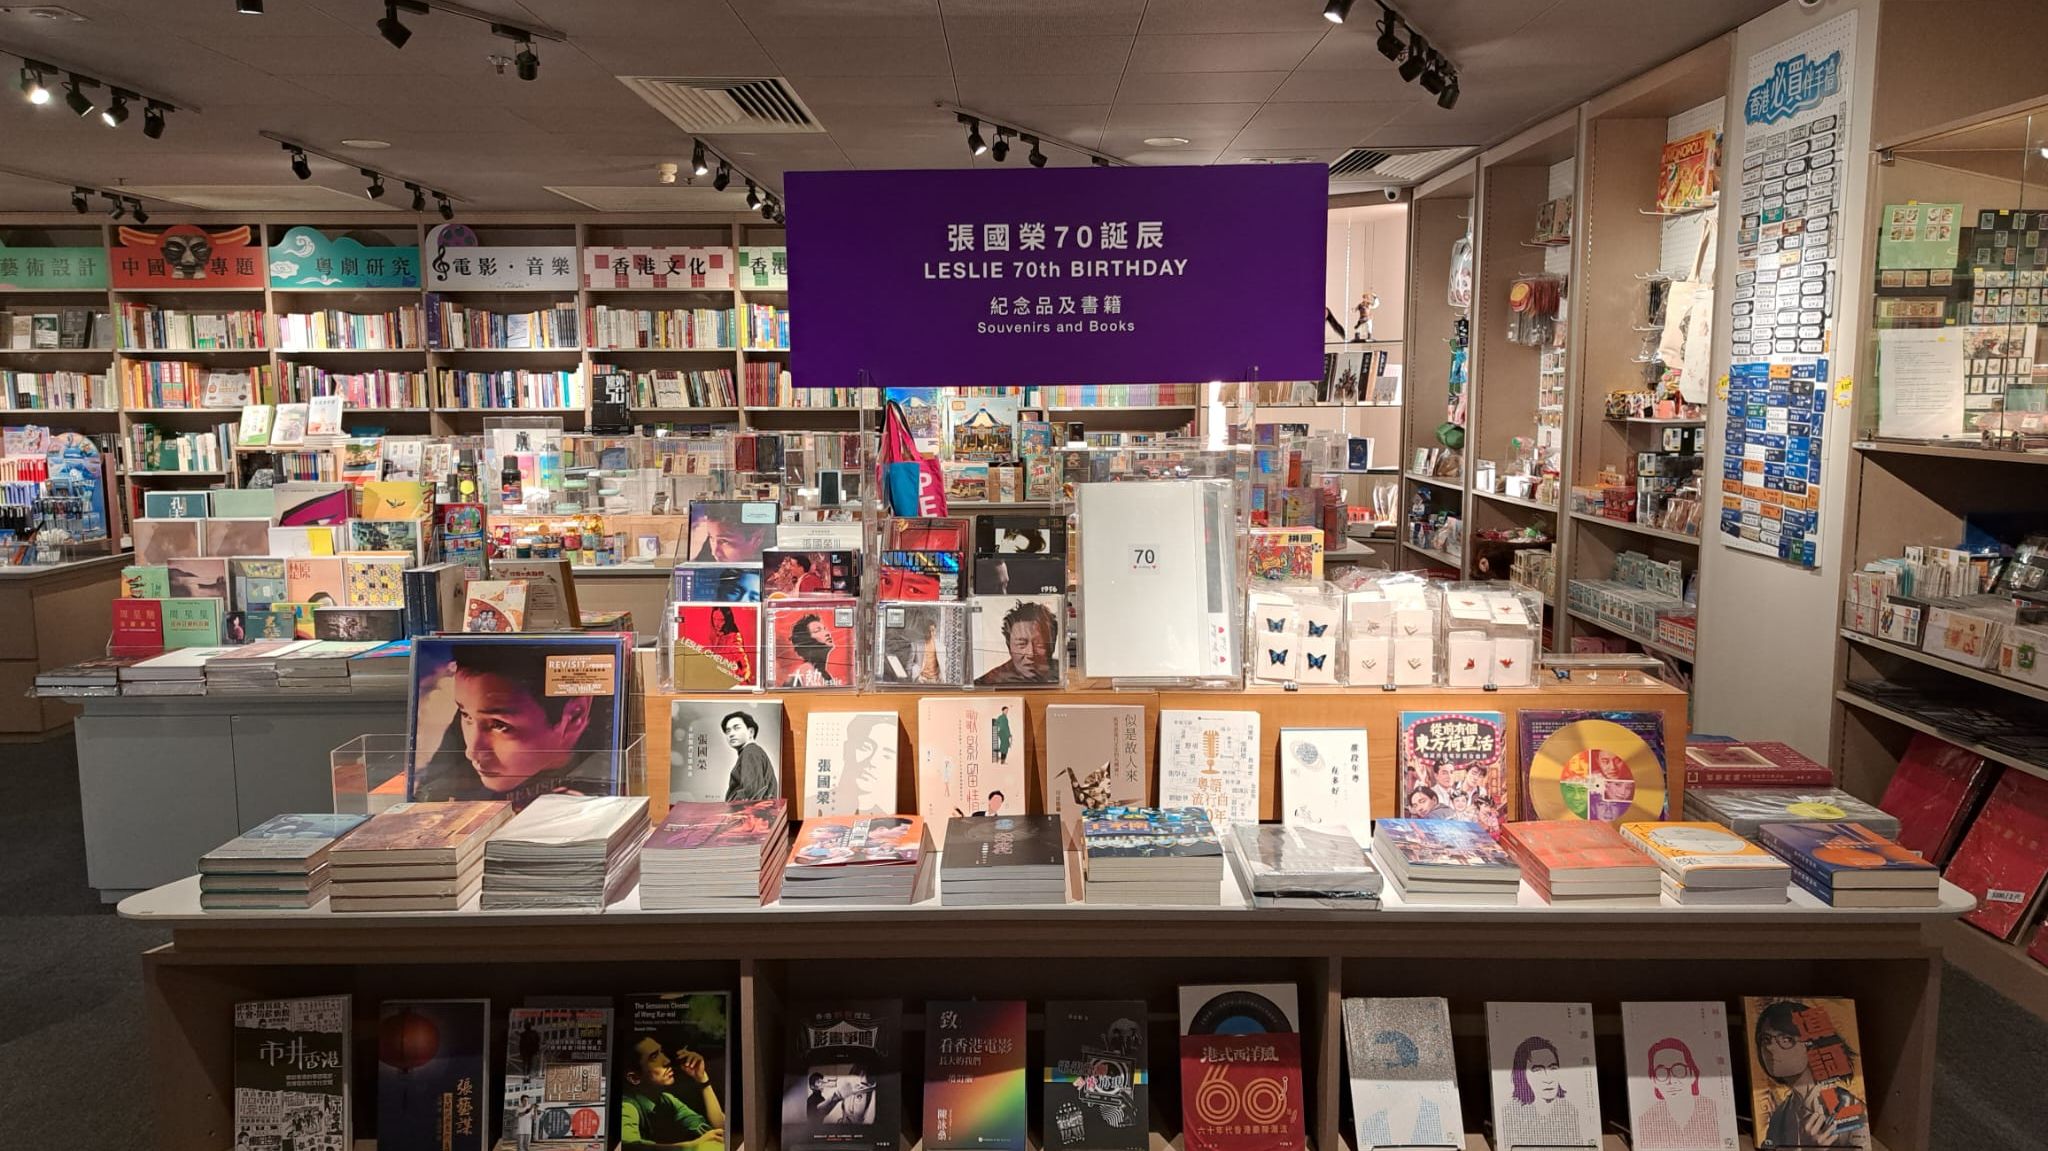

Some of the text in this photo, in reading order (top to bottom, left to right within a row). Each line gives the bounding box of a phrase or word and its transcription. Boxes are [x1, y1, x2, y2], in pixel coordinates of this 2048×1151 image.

[948, 220, 1165, 252] 張國榮70誕辰
[0, 256, 97, 276] 藝術設計
[316, 255, 411, 277] 粵劇研究
[611, 256, 707, 276] 香港文化
[924, 258, 1188, 280] LESLIE 70th BIRTHDAY
[990, 296, 1122, 316] 紀念品及書籍
[977, 320, 1135, 334] Souvenirs and Books
[1133, 549, 1156, 564] 70
[549, 660, 586, 668] REVISIT
[1429, 722, 1479, 736] 從前有個
[696, 734, 708, 770] 張國榮
[1124, 713, 1138, 782] 似是故人來
[1414, 733, 1495, 753] 東方荷里活
[816, 758, 832, 805] 張國榮
[1191, 793, 1229, 807] 流行曲
[939, 1010, 958, 1029] 致
[259, 1036, 343, 1071] 市井香港
[939, 1038, 1015, 1054] 看香港電影
[1199, 1045, 1280, 1063] 港式西洋風
